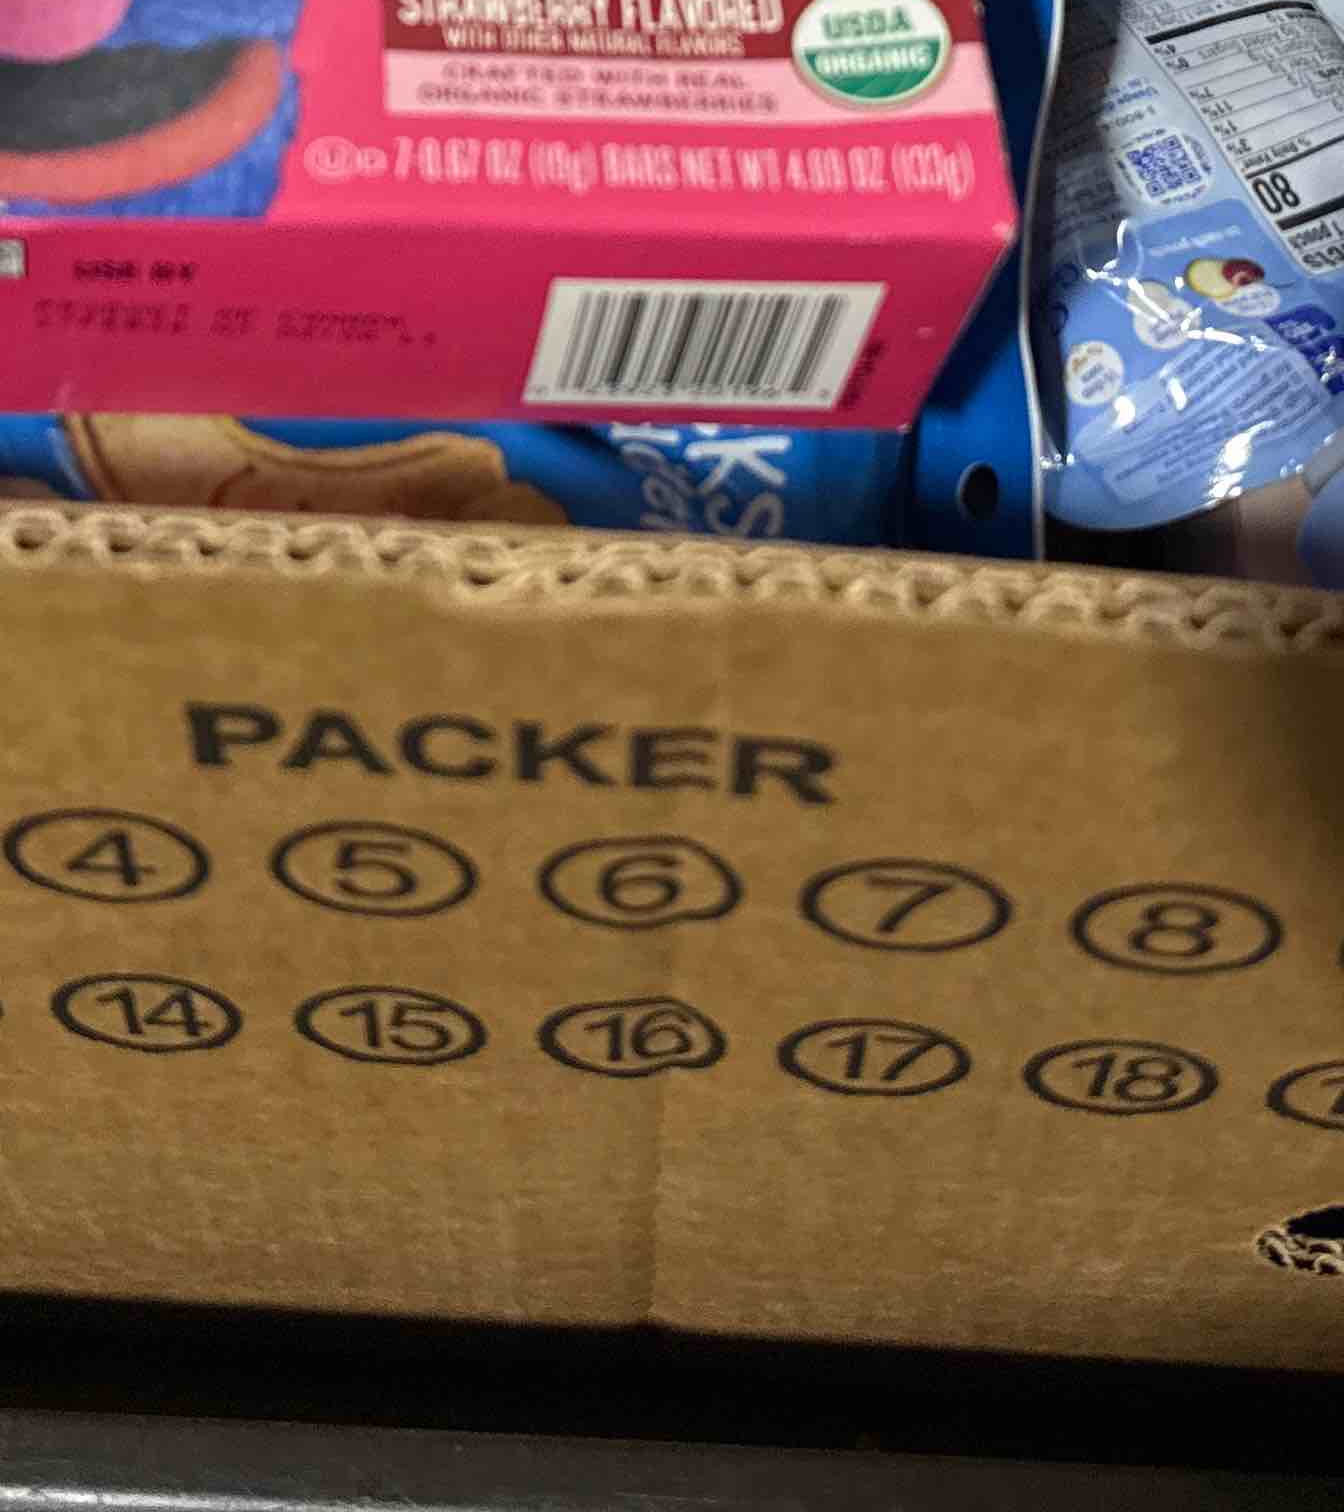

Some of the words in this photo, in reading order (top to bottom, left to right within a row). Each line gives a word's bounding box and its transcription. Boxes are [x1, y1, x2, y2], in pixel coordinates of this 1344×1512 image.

[821, 10, 913, 40] USDA
[1253, 172, 1299, 214] 80
[184, 699, 843, 806] PACKER
